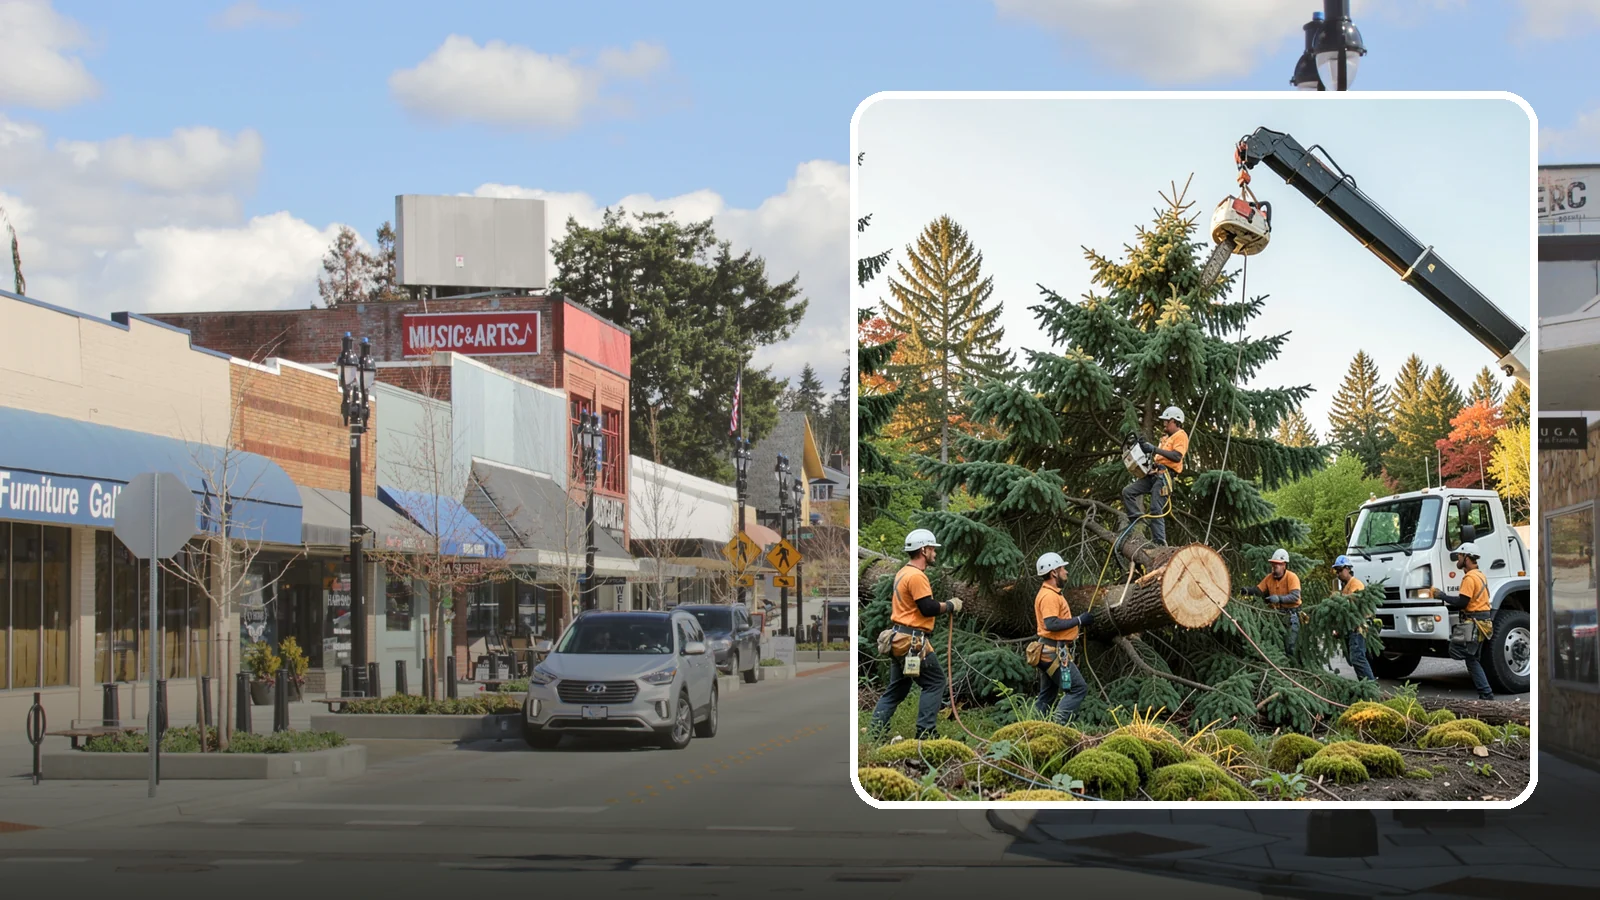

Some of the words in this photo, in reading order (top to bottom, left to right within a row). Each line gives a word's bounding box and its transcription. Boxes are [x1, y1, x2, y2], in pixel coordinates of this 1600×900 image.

[1540, 427, 1578, 437] UGA
[0, 472, 79, 515] Furniture
[89, 482, 122, 519] Gal
[453, 563, 479, 574] SUSHI
